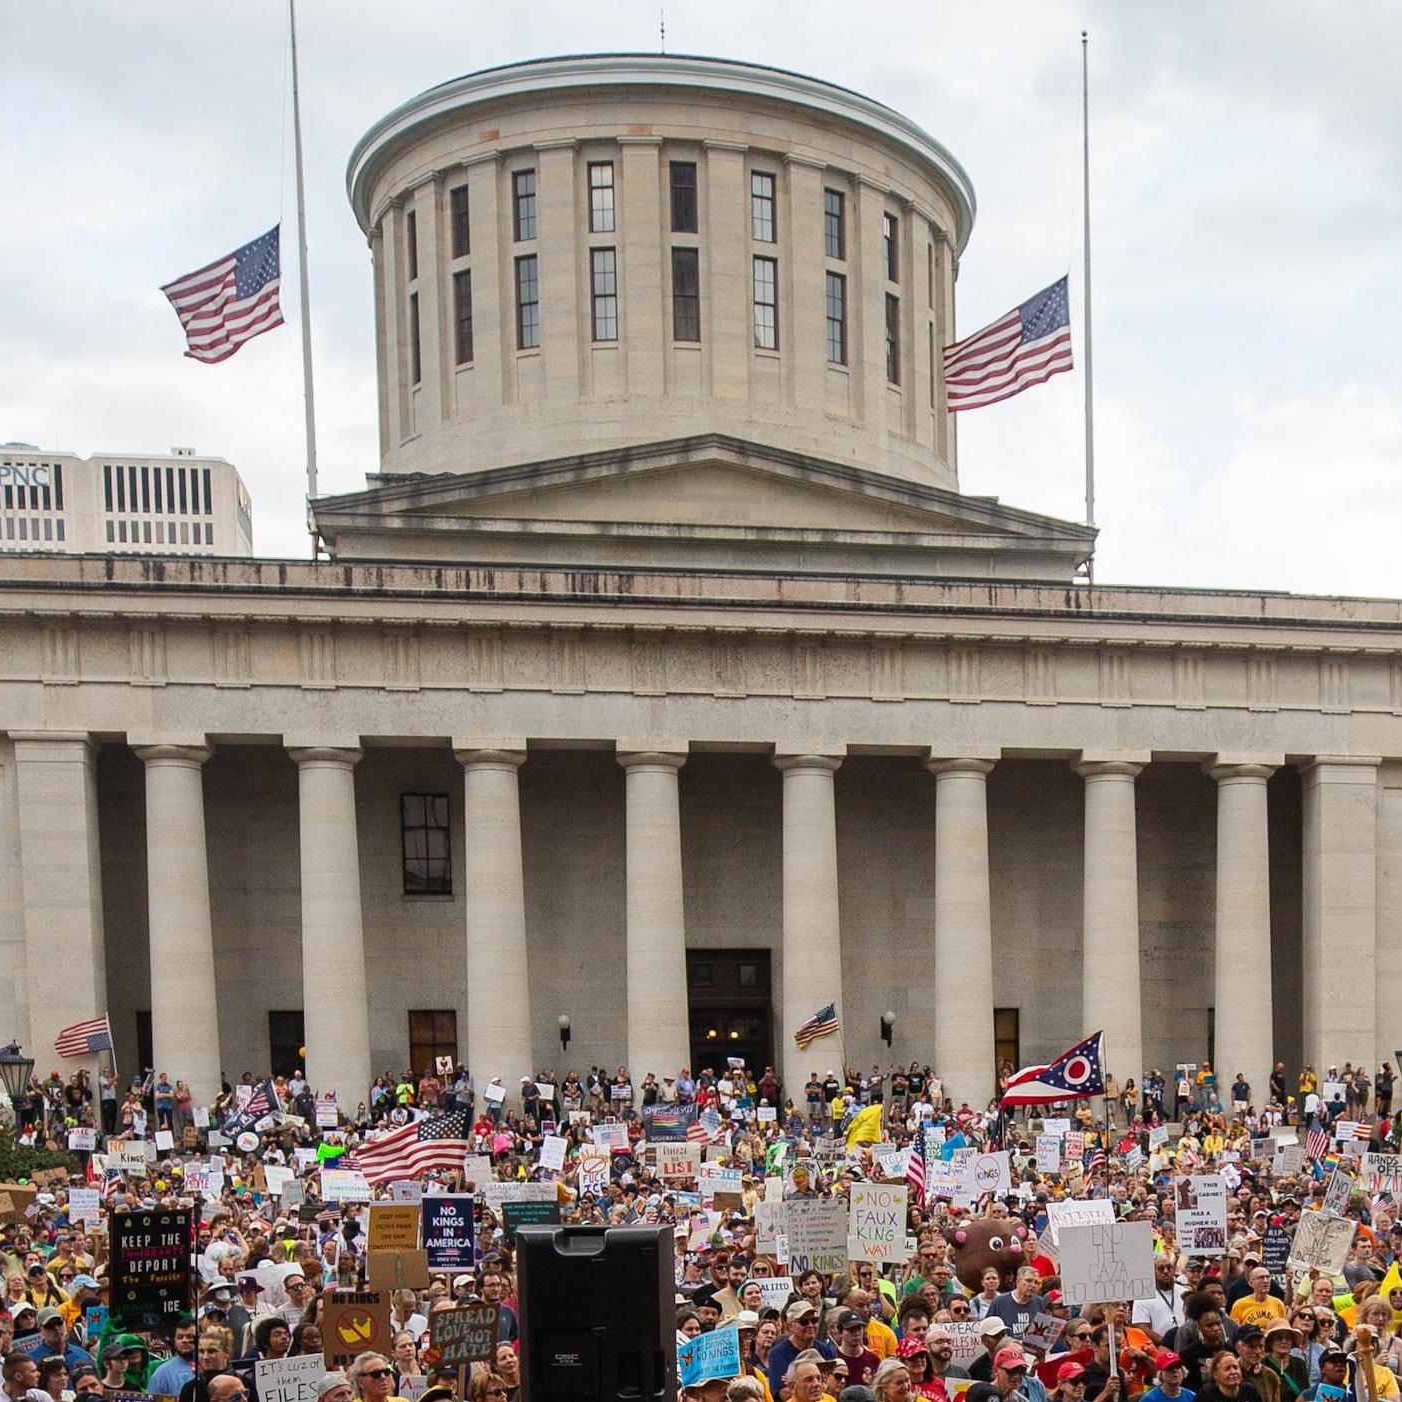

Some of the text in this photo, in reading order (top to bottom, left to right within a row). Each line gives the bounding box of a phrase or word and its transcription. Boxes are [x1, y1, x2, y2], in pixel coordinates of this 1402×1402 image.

[110, 1141, 125, 1152] NO
[1368, 1155, 1399, 1166] HANDS
[583, 1171, 606, 1184] FUCK
[977, 1169, 999, 1181] KINGS
[1335, 1178, 1349, 1195] NO
[866, 1191, 892, 1207] NO
[440, 1206, 457, 1216] NO
[856, 1209, 898, 1226] FAUX
[432, 1217, 465, 1228] KINGS
[442, 1228, 455, 1237] IN
[857, 1226, 895, 1242] KING
[121, 1233, 180, 1248] KEEP THE
[426, 1238, 471, 1248] AMERICA
[862, 1243, 892, 1256] WAY!
[129, 1258, 178, 1273] DEPORT
[790, 1254, 844, 1273] NO KINGS
[1088, 1261, 1129, 1281] GAZA
[331, 1291, 380, 1305] NO KINGS
[163, 1300, 181, 1313] ICE
[435, 1307, 497, 1328] SPREAD
[1017, 1312, 1030, 1324] NO
[435, 1321, 493, 1344] LOVE NOT
[441, 1341, 492, 1361] HATE
[276, 1375, 302, 1385] them
